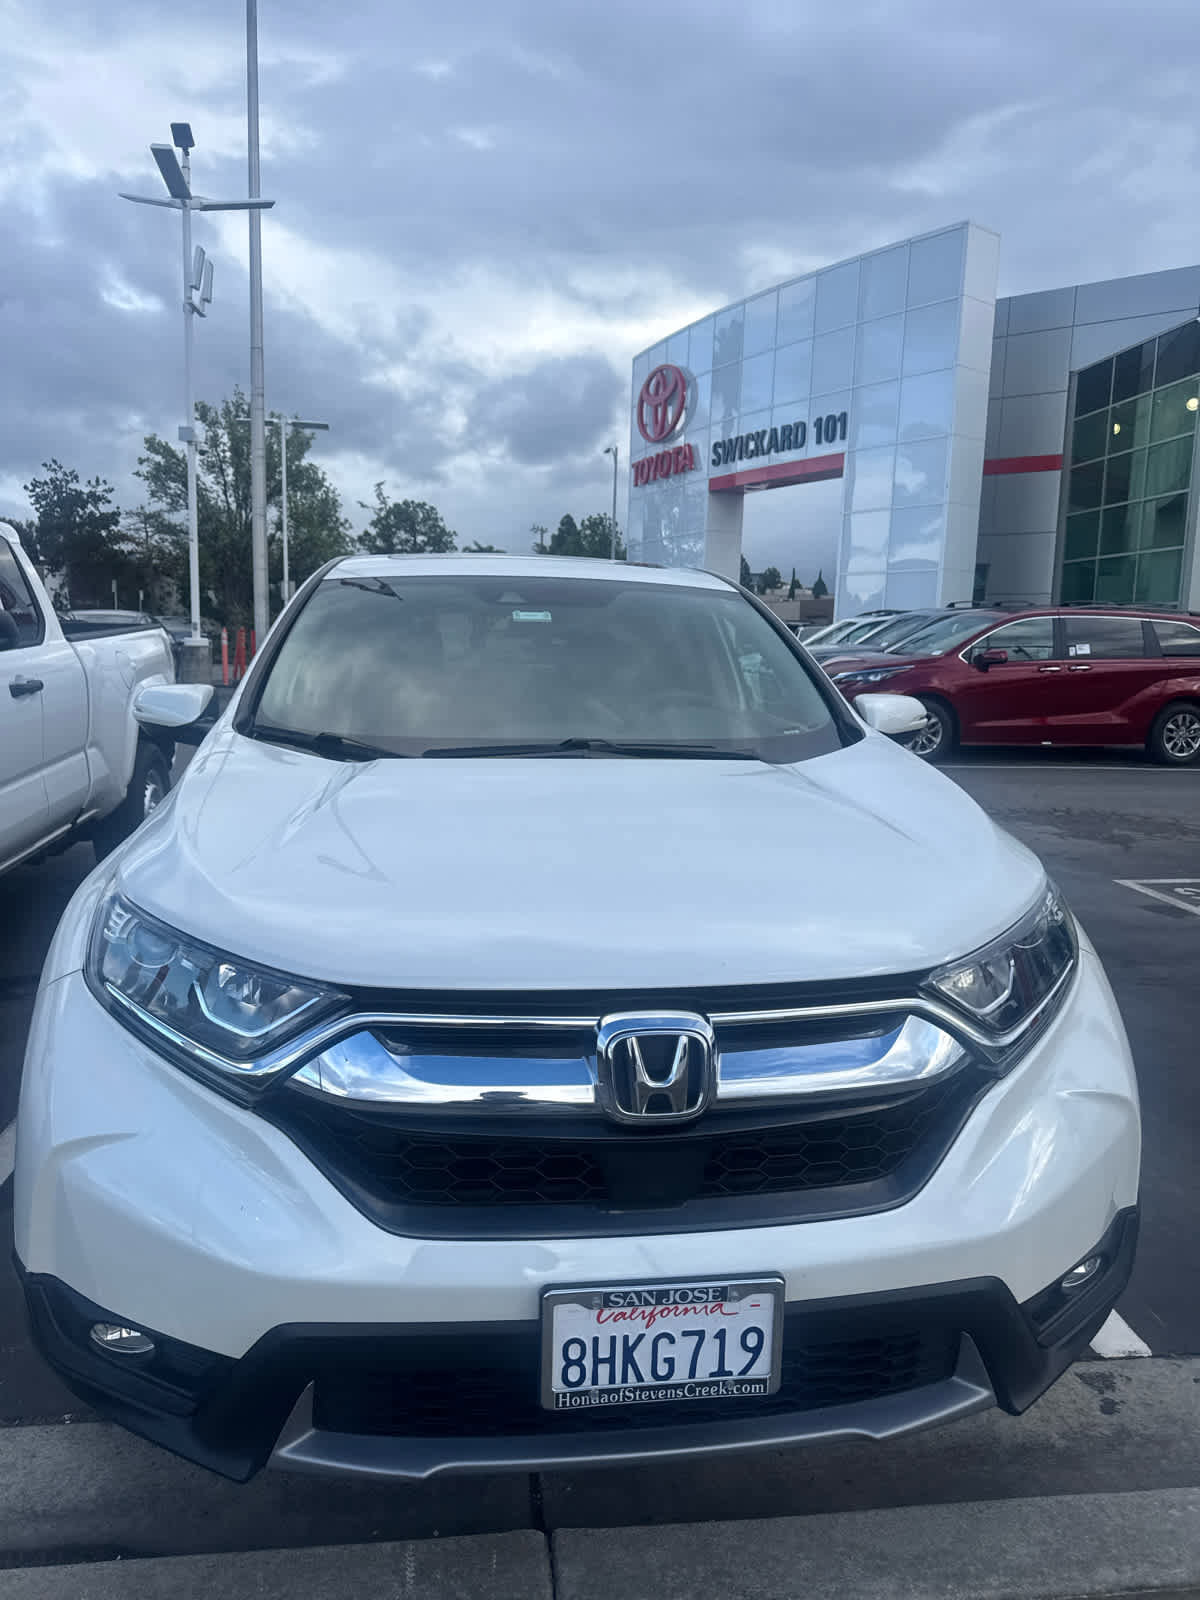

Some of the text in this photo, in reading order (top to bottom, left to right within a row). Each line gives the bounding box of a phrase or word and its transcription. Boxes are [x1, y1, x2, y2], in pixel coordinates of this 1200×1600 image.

[711, 411, 848, 467] SWICKARD 101
[632, 443, 694, 487] TOYOTA
[609, 1287, 722, 1307] SAN JOSE
[561, 1326, 765, 1388] 8HKG719
